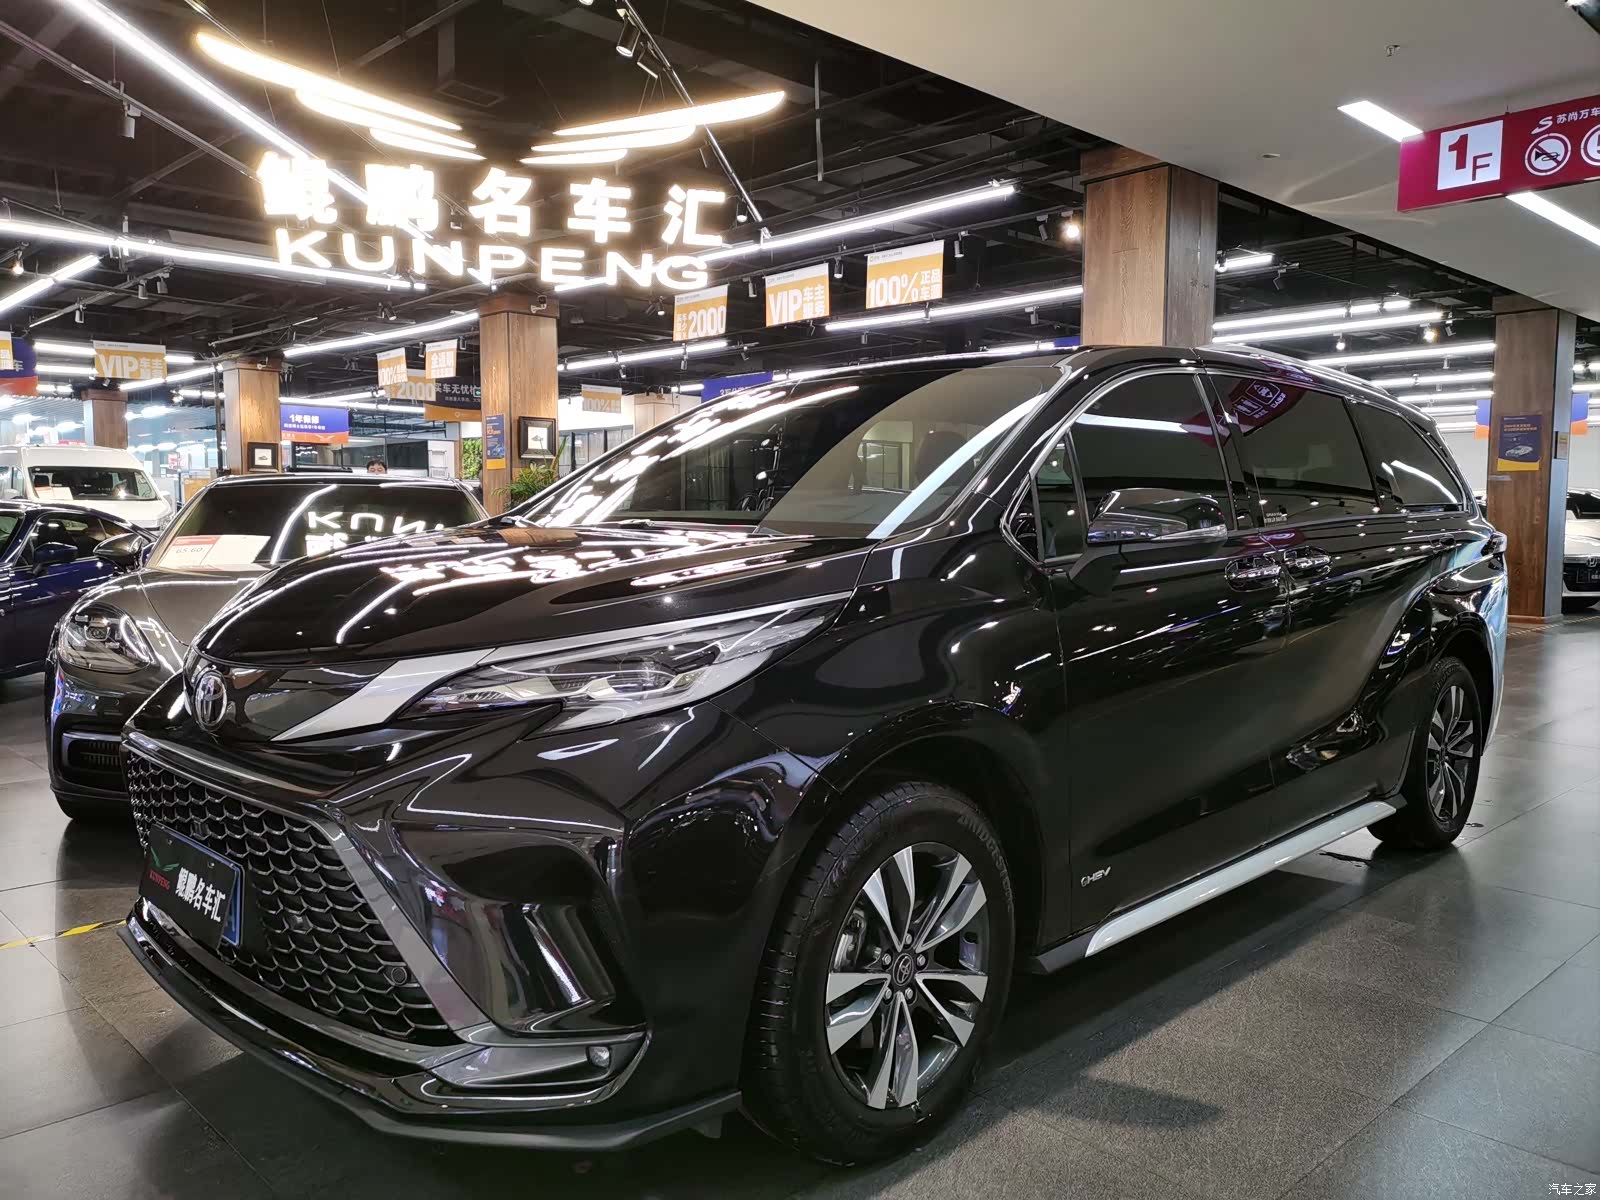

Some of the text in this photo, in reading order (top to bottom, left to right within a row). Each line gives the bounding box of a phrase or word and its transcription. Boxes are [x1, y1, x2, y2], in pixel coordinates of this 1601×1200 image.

[275, 228, 709, 290] KUNPENG
[688, 305, 727, 340] 2000
[768, 288, 803, 325] VIP
[98, 354, 139, 380] VIP
